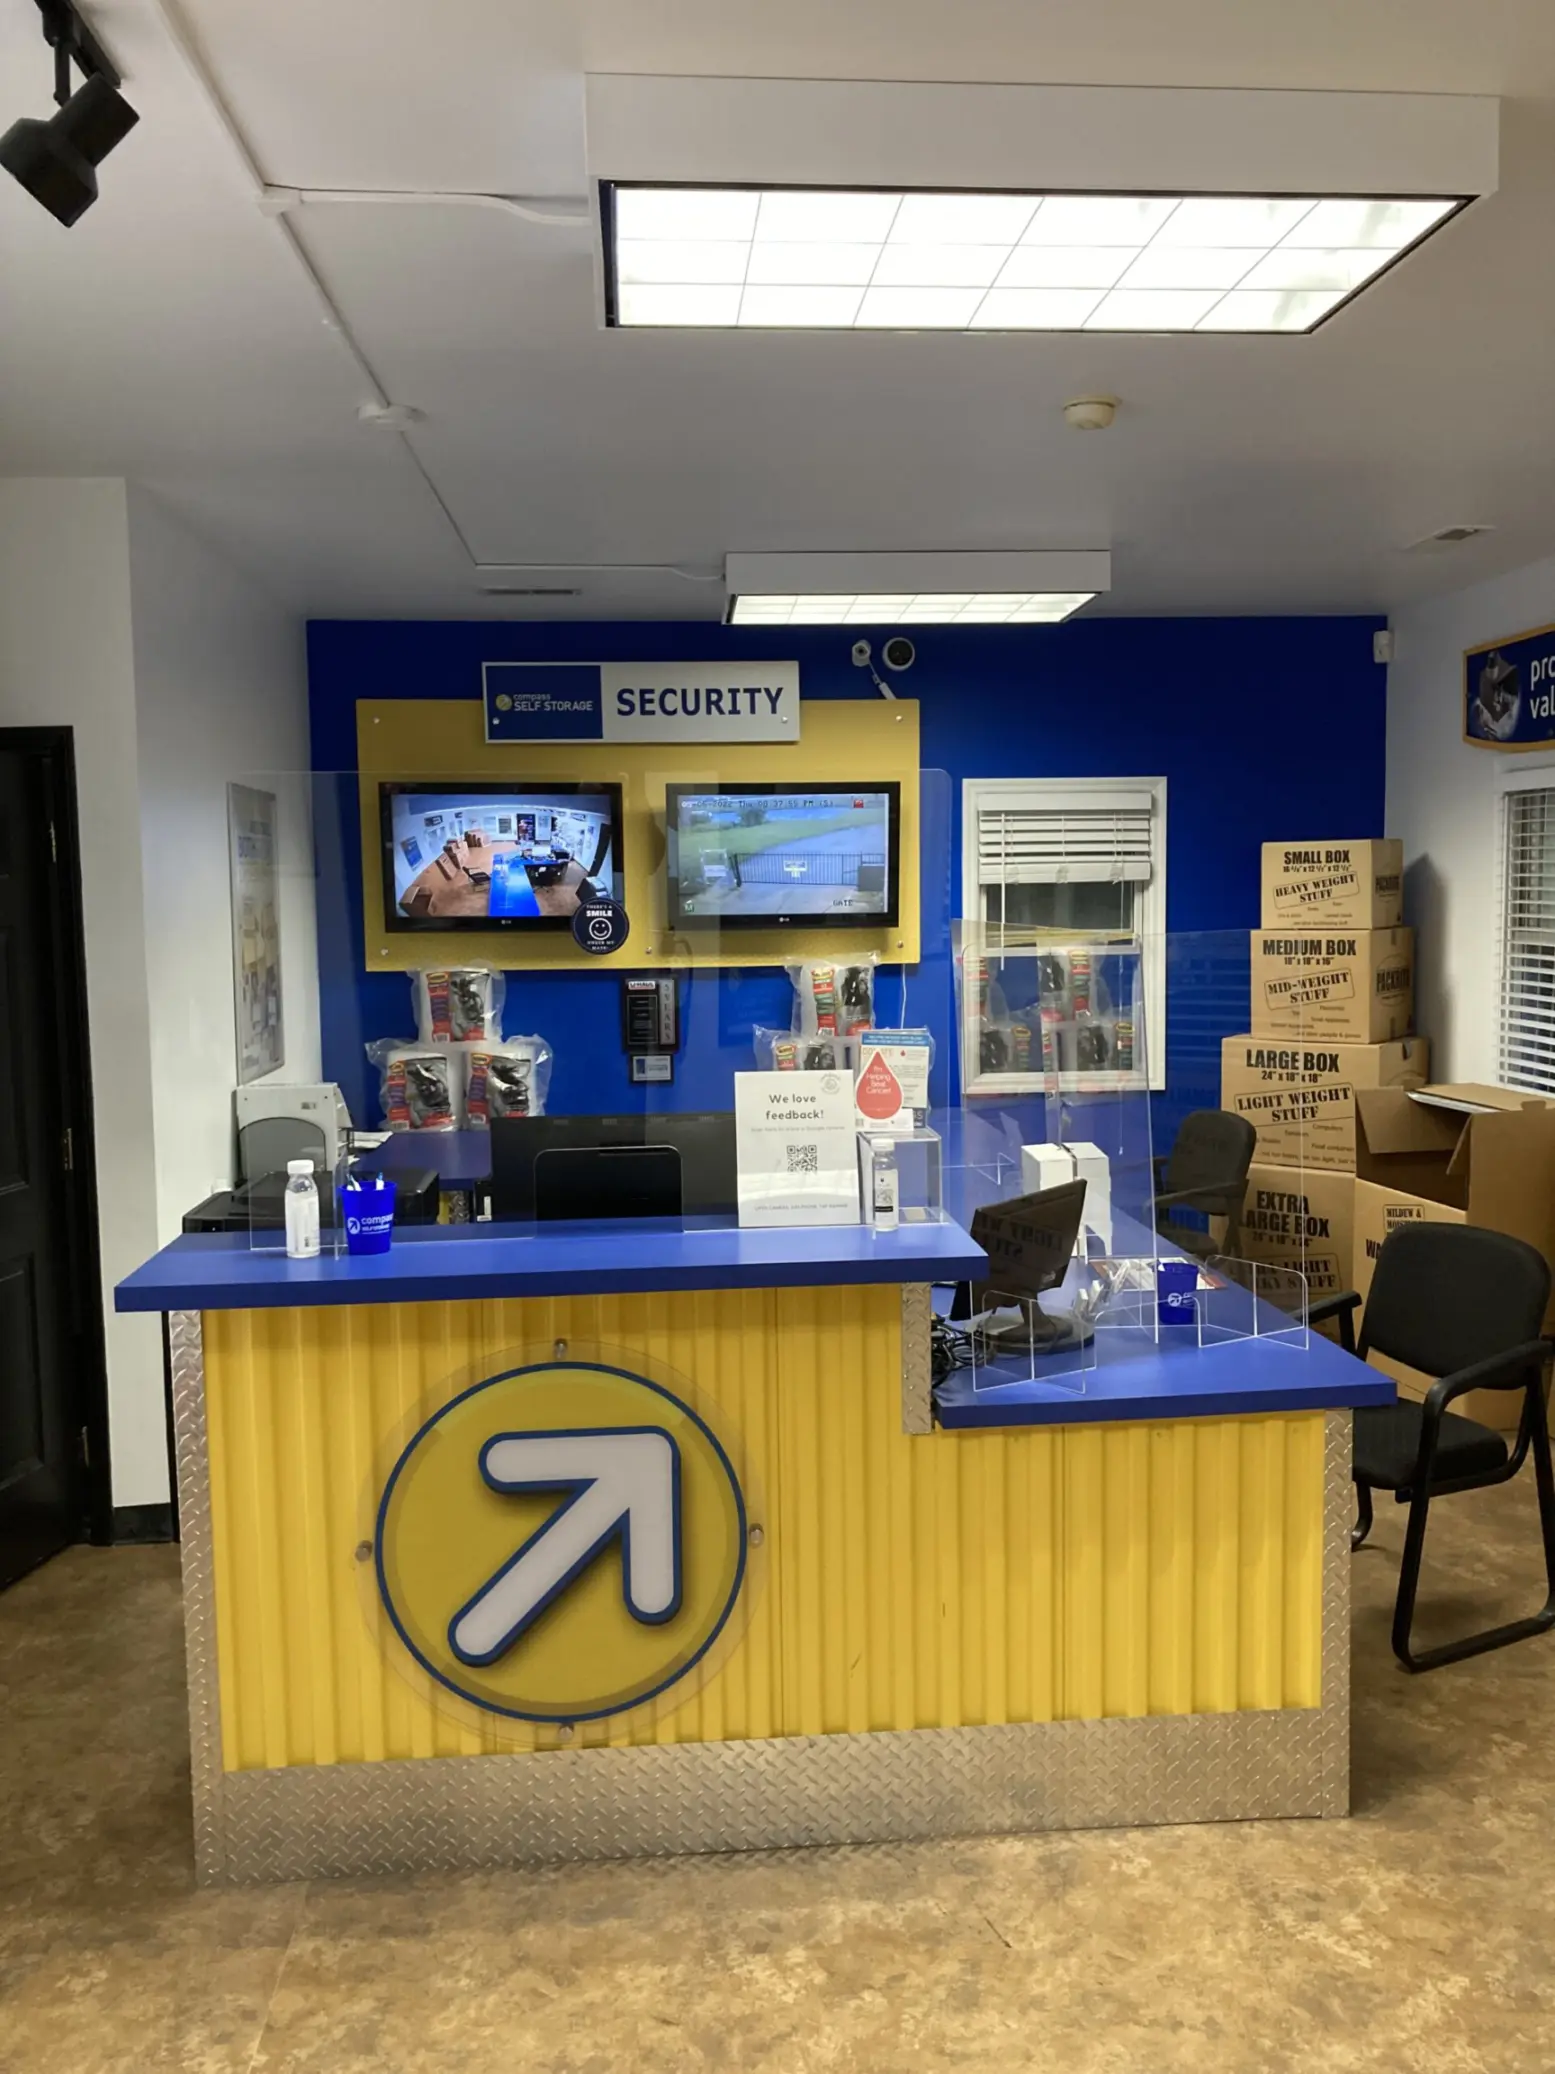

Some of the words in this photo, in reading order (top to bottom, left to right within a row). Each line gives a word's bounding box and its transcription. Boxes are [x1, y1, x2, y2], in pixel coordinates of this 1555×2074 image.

[513, 693, 551, 703] compass
[513, 700, 541, 712] SELF
[543, 700, 594, 711] STORAGE
[616, 687, 784, 717] SECURITY
[1529, 684, 1555, 719] val
[1283, 850, 1323, 865] SMALL
[1325, 849, 1350, 864] BOX
[1275, 883, 1309, 898] HEAVY
[1313, 873, 1356, 891] WEIGHT
[833, 899, 854, 907] GATE
[1299, 888, 1333, 903] STUFF
[1262, 939, 1322, 955] MEDIUM
[1325, 939, 1357, 956] BOX
[1267, 971, 1349, 995] MID-WEIGHT
[1290, 987, 1330, 1004] STUFF
[1246, 1048, 1299, 1071] LARGE
[1303, 1051, 1340, 1073] BOX
[1261, 1070, 1277, 1080] 24"
[768, 1093, 789, 1104] We
[792, 1093, 817, 1104] love
[1237, 1094, 1284, 1112] LIGHT
[1289, 1087, 1350, 1106] WEIGHT
[765, 1109, 824, 1121] feedback!
[1271, 1106, 1319, 1123] STUFF
[1256, 1190, 1310, 1214] EXTRA
[1386, 1207, 1413, 1218] MILDEW
[1416, 1208, 1422, 1218] &
[1294, 1214, 1330, 1239] BOX
